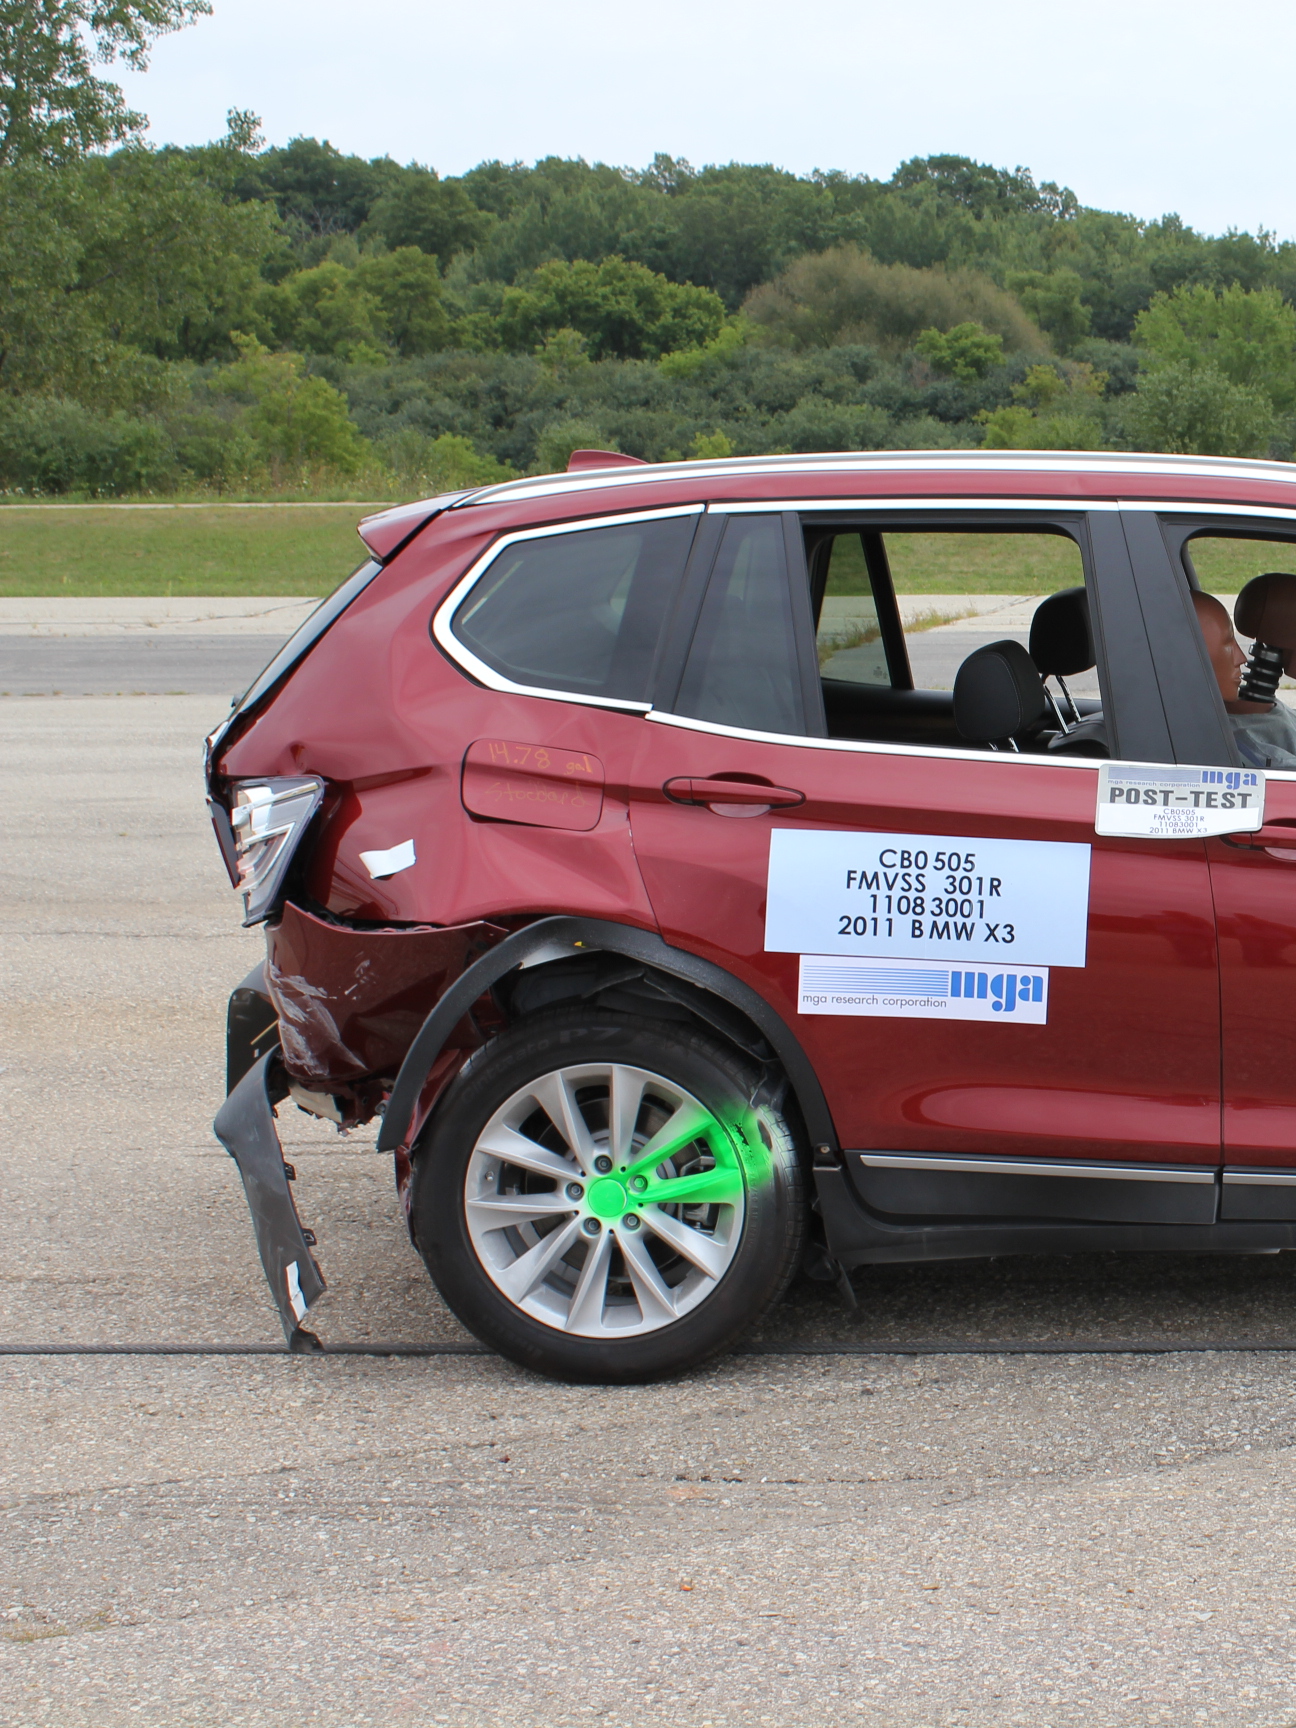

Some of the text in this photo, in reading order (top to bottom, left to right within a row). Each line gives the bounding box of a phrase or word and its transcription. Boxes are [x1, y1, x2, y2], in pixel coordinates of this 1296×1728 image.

[488, 741, 594, 775] 14.78 gal
[1202, 770, 1258, 790] mga
[1109, 787, 1252, 809] POST-TEST
[1153, 814, 1182, 822] FMVSS
[1163, 808, 1196, 816] CB0505
[846, 870, 1002, 898] FMVSS 301R
[838, 915, 1015, 944] 2011 BMW X3
[802, 994, 947, 1009] mga research corporation
[950, 970, 1044, 1012] mga
